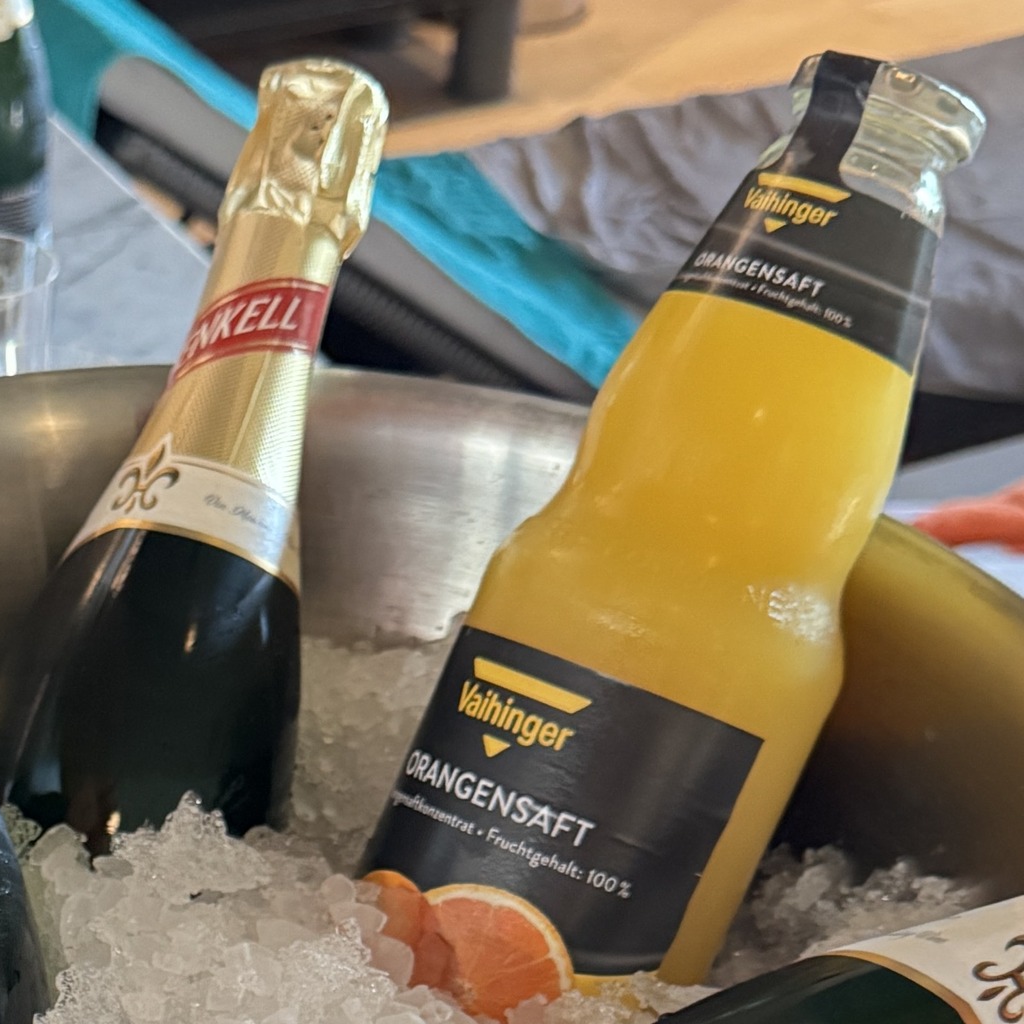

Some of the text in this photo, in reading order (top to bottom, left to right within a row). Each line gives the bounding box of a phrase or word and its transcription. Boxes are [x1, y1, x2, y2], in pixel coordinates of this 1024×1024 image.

[743, 187, 838, 227] Vaihinger
[693, 251, 825, 297] ORANGENSAFT
[458, 680, 574, 751] Vaihinger
[405, 750, 596, 847] ORANGENSAFT
[485, 826, 583, 880] Fruchtgehalt:
